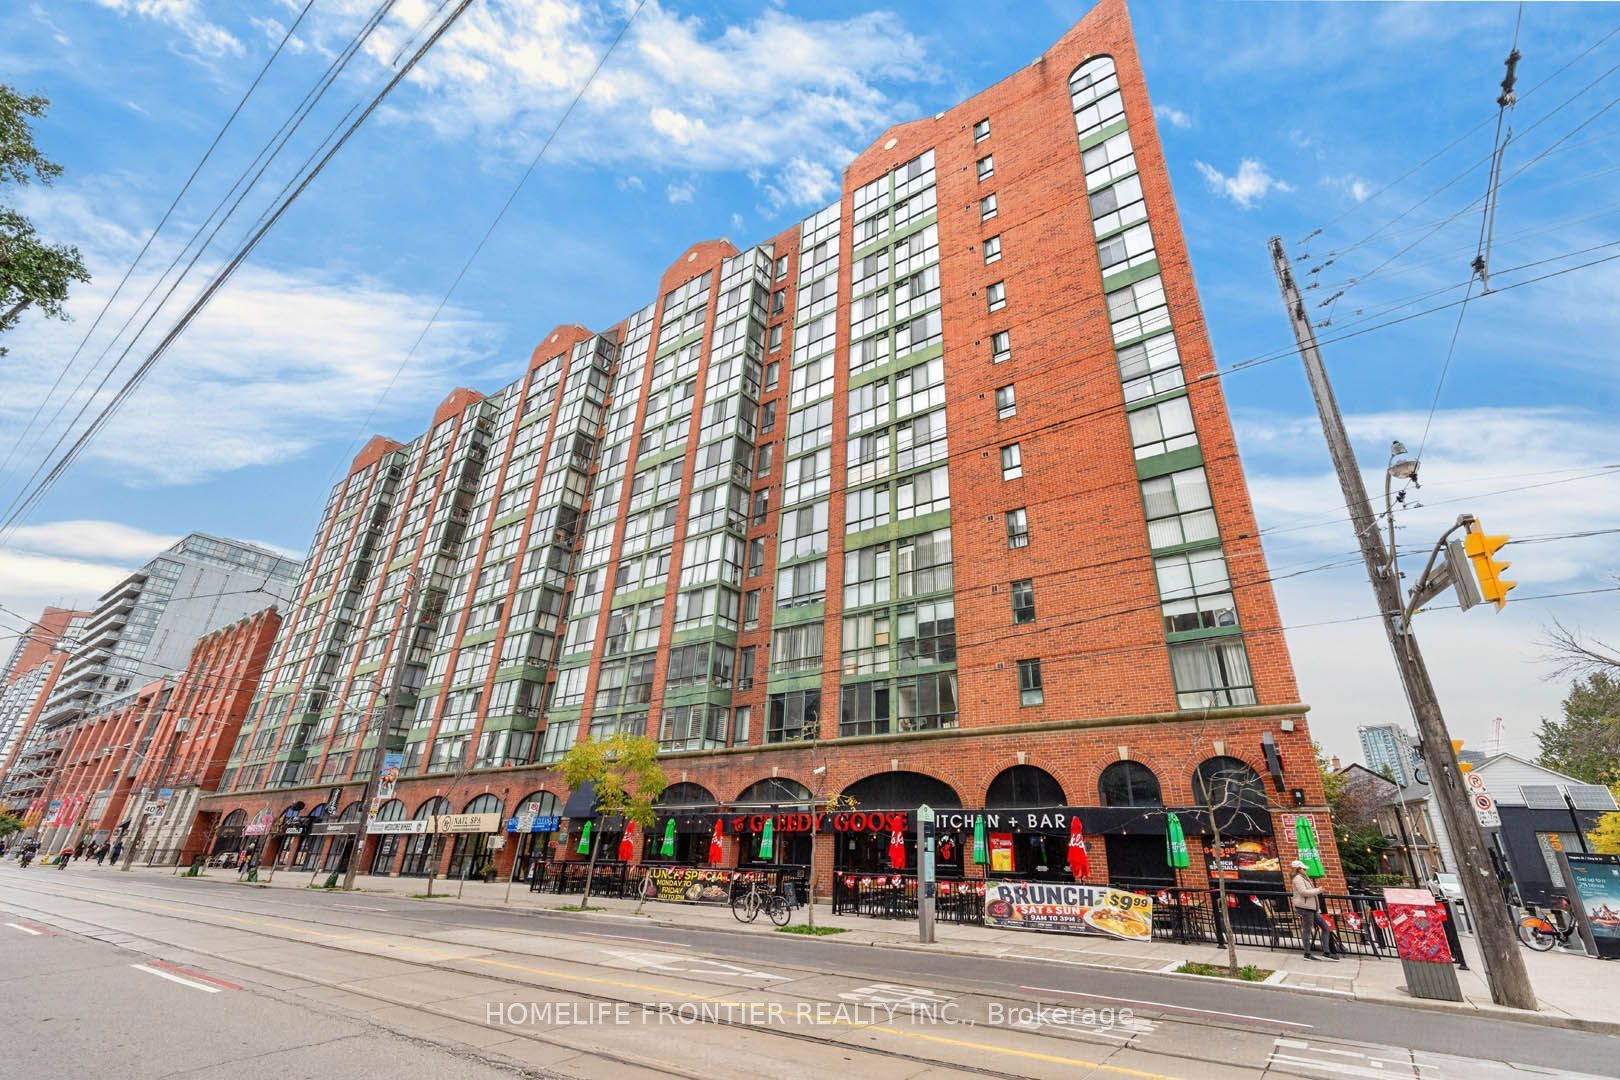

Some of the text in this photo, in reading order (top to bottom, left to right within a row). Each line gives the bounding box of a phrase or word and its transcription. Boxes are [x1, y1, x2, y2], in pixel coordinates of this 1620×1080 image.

[835, 811, 908, 832] GOOSE
[936, 814, 1000, 828] ITCHN
[1028, 814, 1066, 829] BAR
[685, 870, 731, 882] SPECAL
[656, 879, 682, 887] MONDAY
[998, 885, 1094, 907] BRUNCH
[1022, 905, 1080, 916] SAT & SUN
